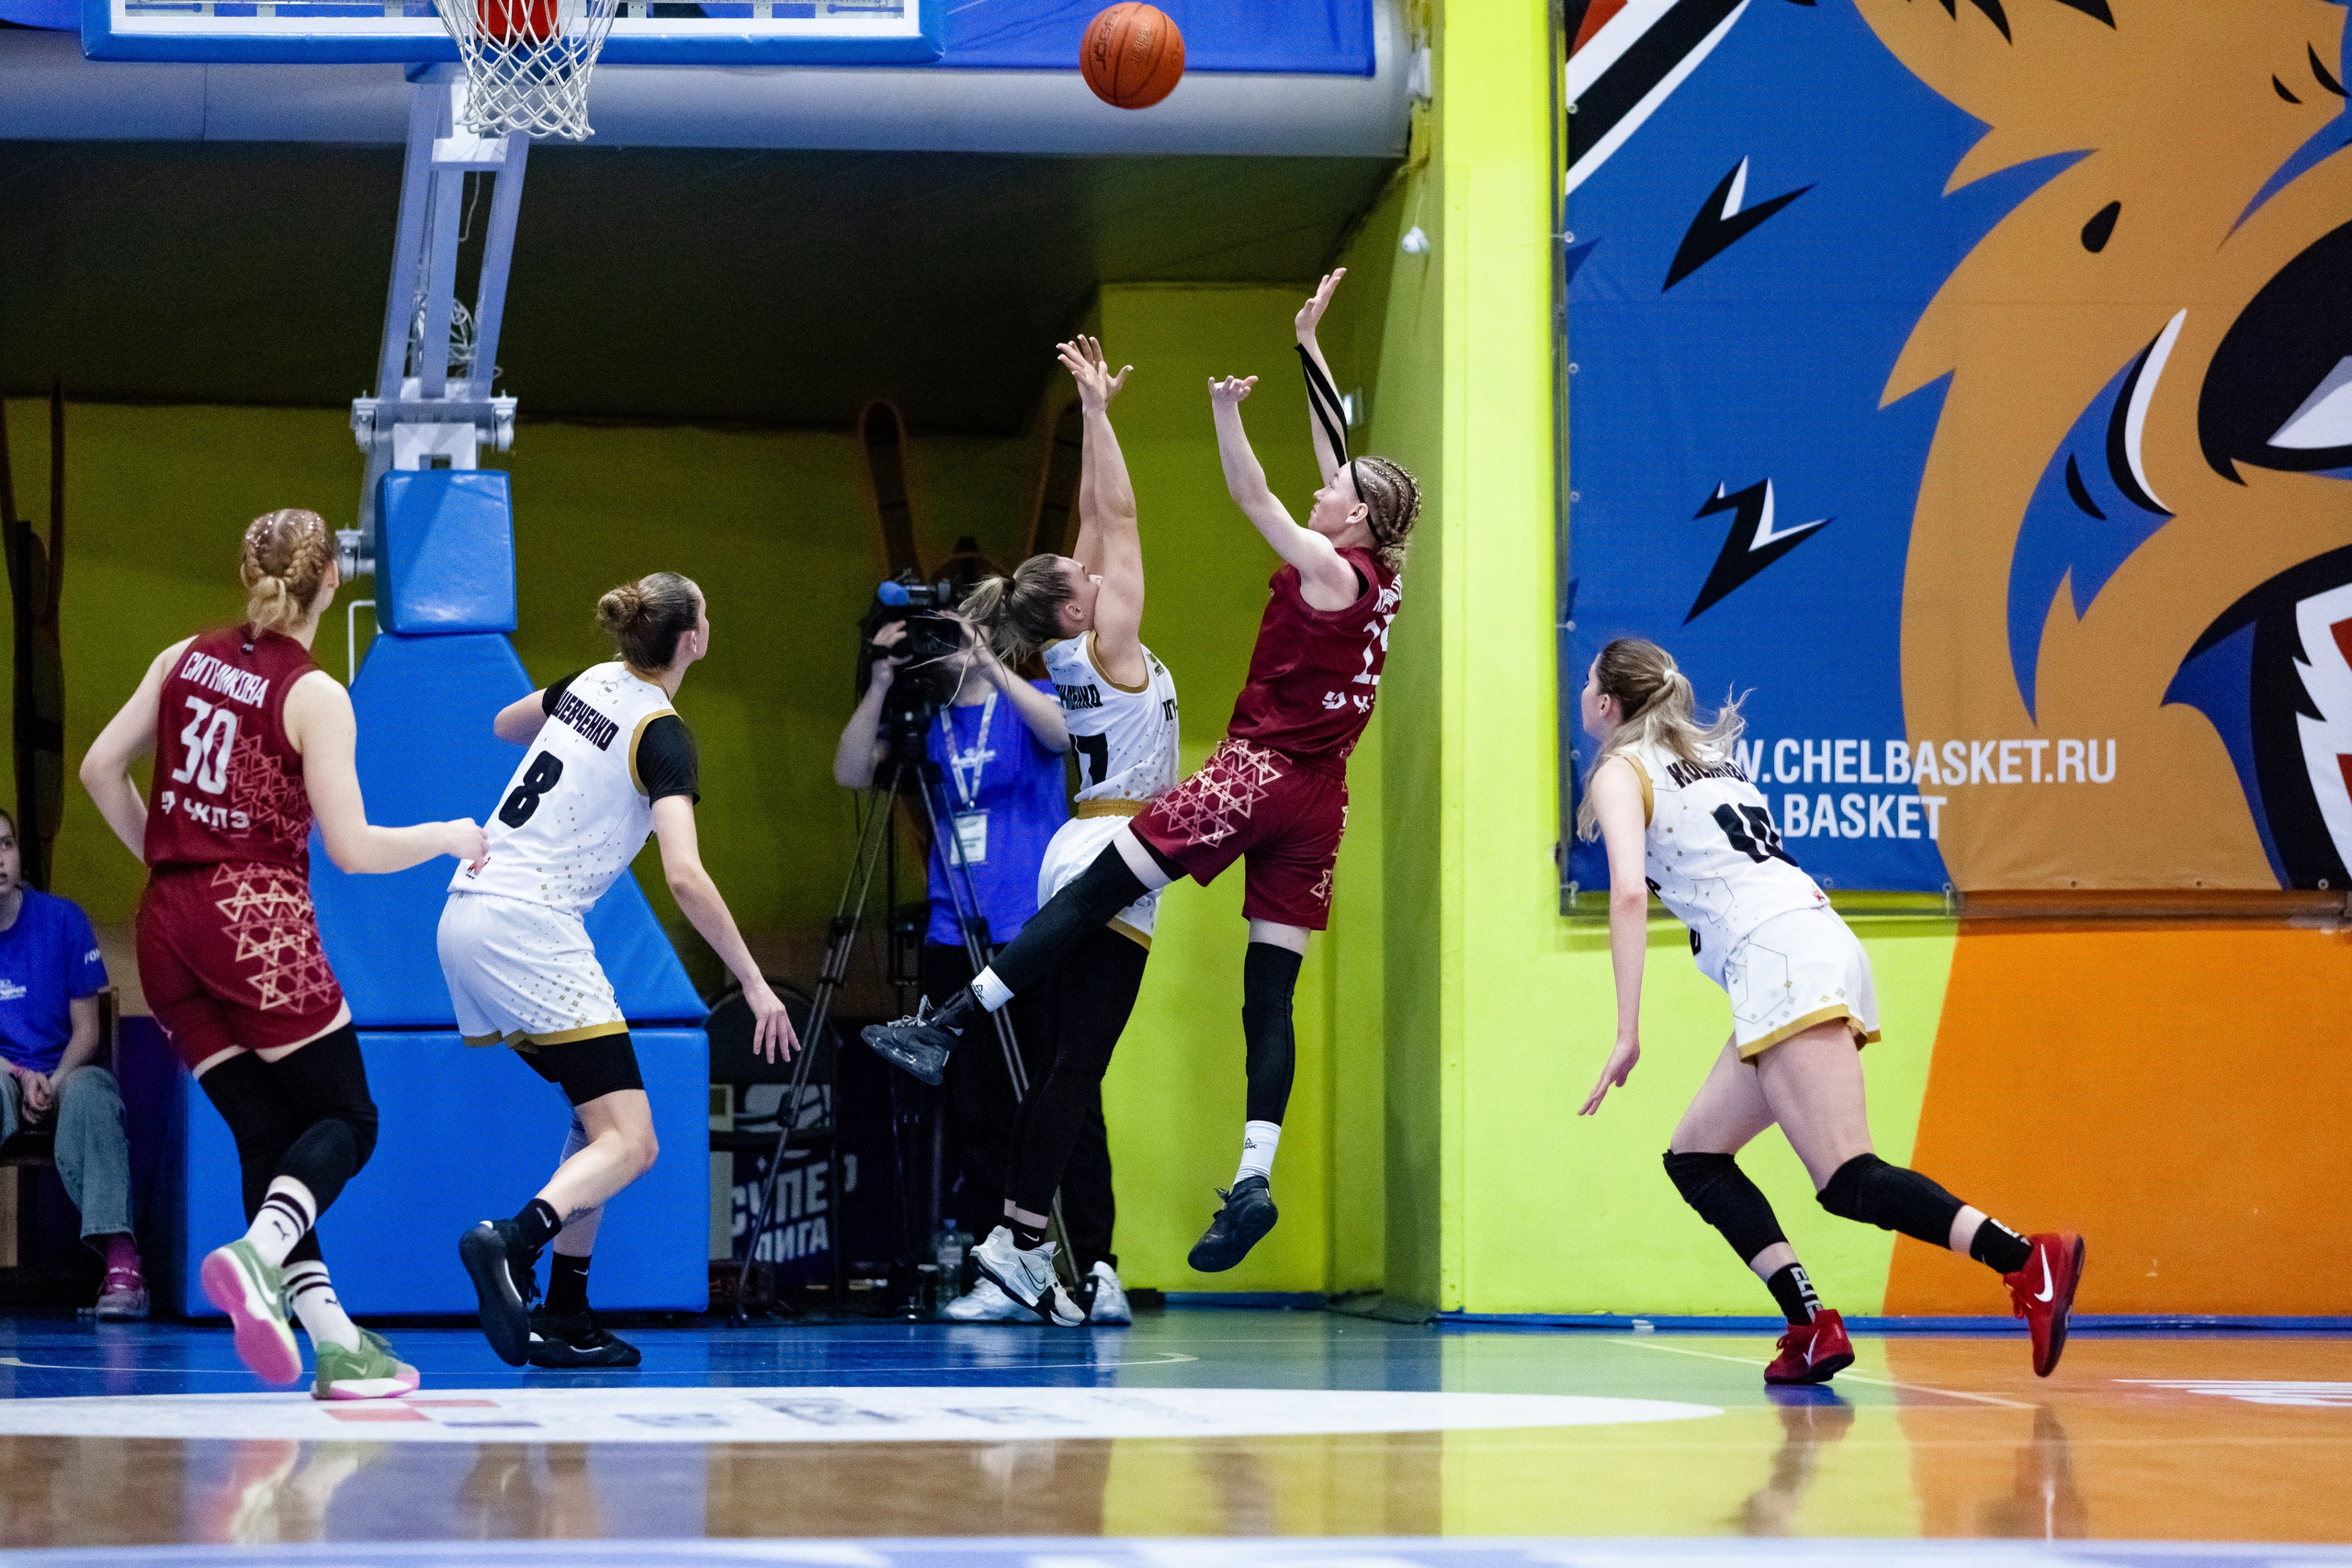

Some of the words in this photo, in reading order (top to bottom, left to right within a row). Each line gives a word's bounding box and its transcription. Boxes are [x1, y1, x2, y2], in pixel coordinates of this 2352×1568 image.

[180, 651, 269, 708] СИТНИКОВА
[172, 695, 237, 795] 30
[551, 689, 620, 751] ШЕВЧЕНКО
[499, 750, 563, 829] 8
[754, 1216, 829, 1264] ЛИГА
